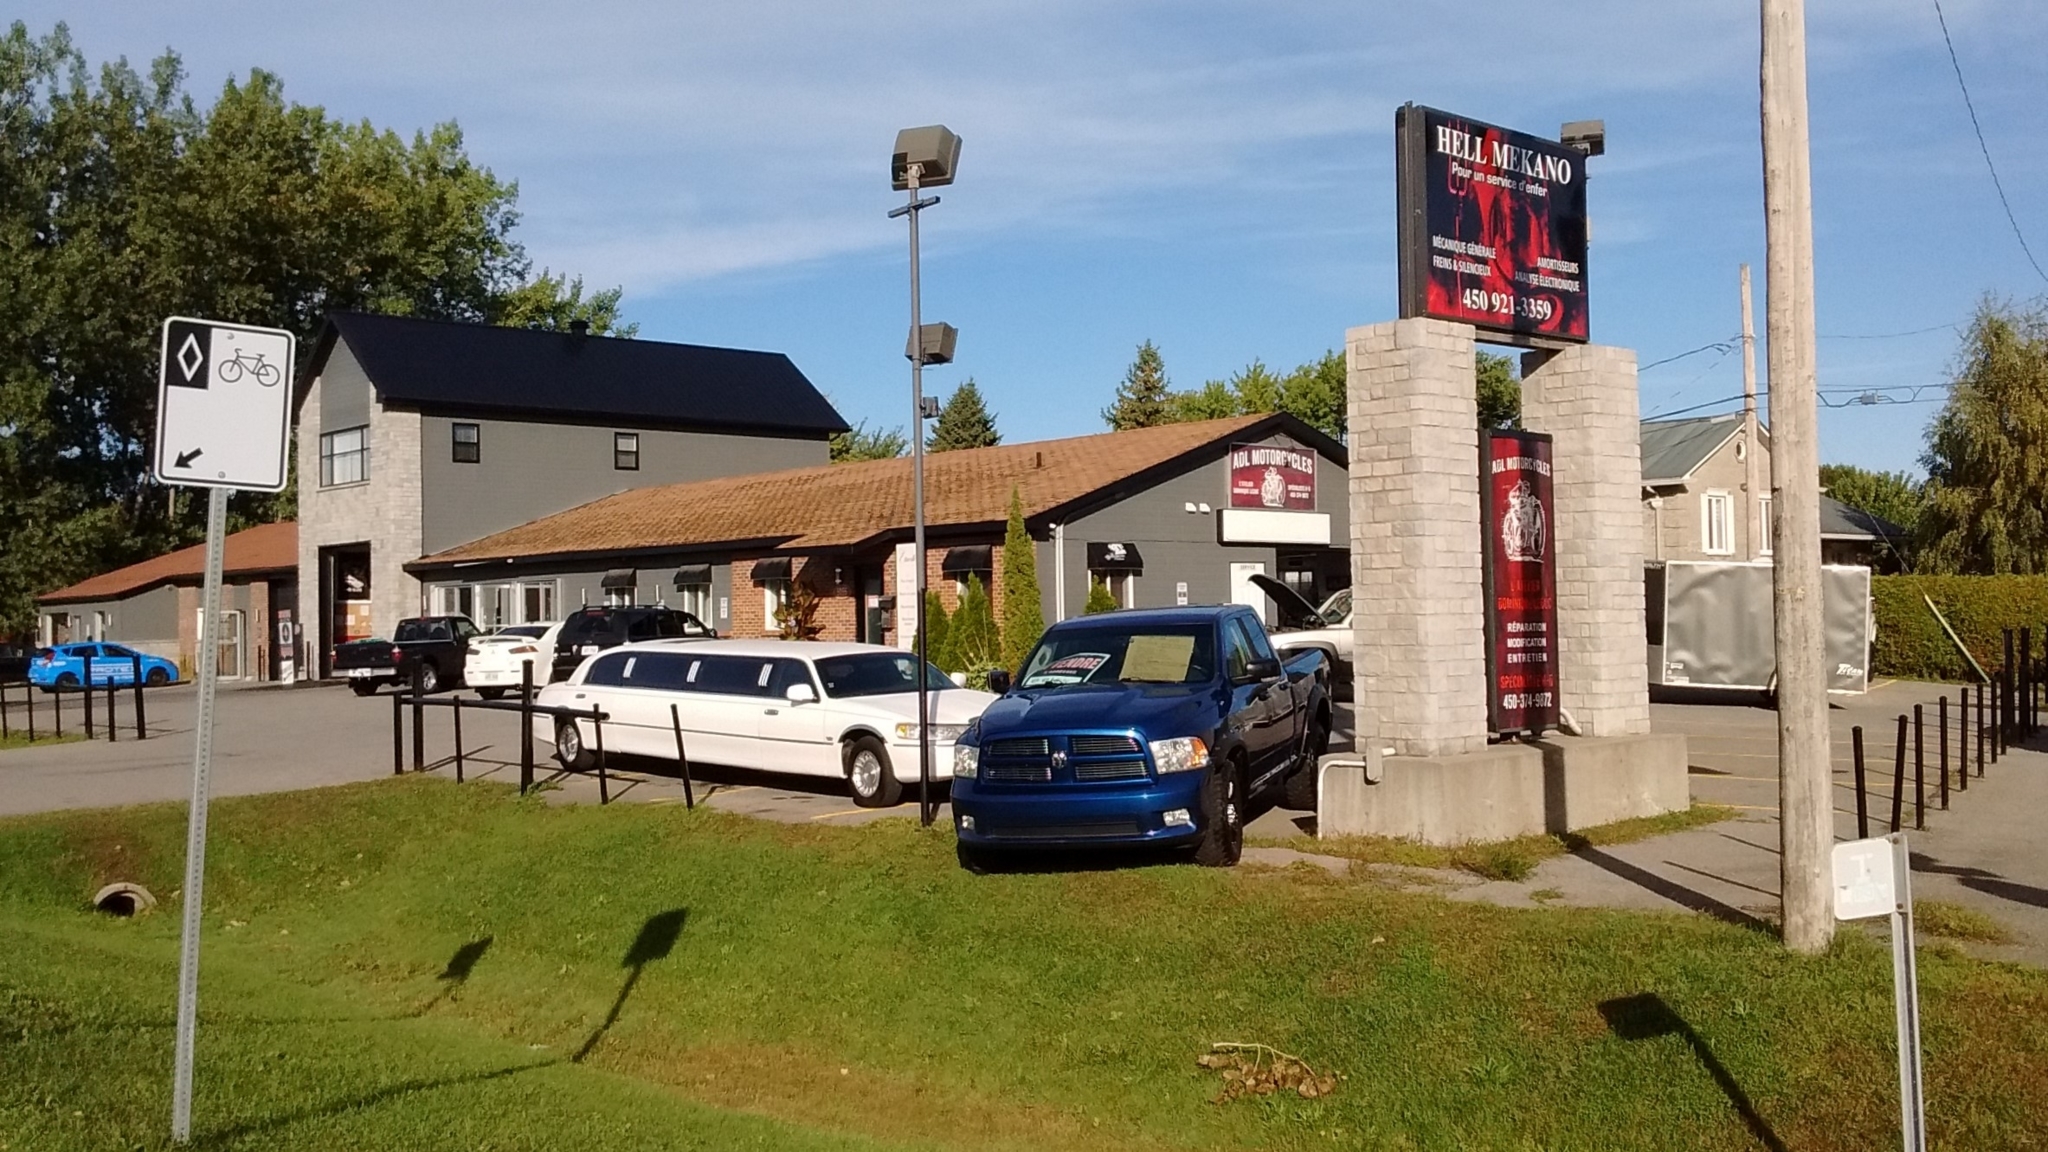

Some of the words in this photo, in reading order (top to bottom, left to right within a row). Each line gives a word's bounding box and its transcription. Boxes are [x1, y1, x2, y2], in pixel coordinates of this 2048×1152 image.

[1436, 125, 1487, 164] HELL
[1492, 141, 1572, 184] MEKANO
[1452, 161, 1471, 178] Pour
[1474, 171, 1485, 182] un
[1486, 173, 1517, 189] service
[1432, 233, 1466, 253] MÉCANIQUE
[1466, 240, 1496, 259] GÉNÉRALE
[1433, 255, 1452, 269] FREINS
[1453, 259, 1458, 271] &
[1458, 260, 1492, 277] SILENCIEUX
[1537, 256, 1579, 274] AMORTISSEURS
[1515, 271, 1539, 286] ANALYSE
[1539, 273, 1580, 292] ÉLECTRONIQUE
[1462, 287, 1488, 311] 450
[1491, 292, 1552, 320] 921-3359
[1233, 451, 1250, 469] ADL
[1252, 449, 1313, 474] MOTORCYCLES
[1492, 458, 1506, 474] ADL
[1507, 456, 1551, 477] MOTORCYCLES
[1507, 621, 1547, 632] RÉPARATION
[1507, 637, 1547, 648] MODIFICATION
[1507, 653, 1548, 664] ENTRETIEN
